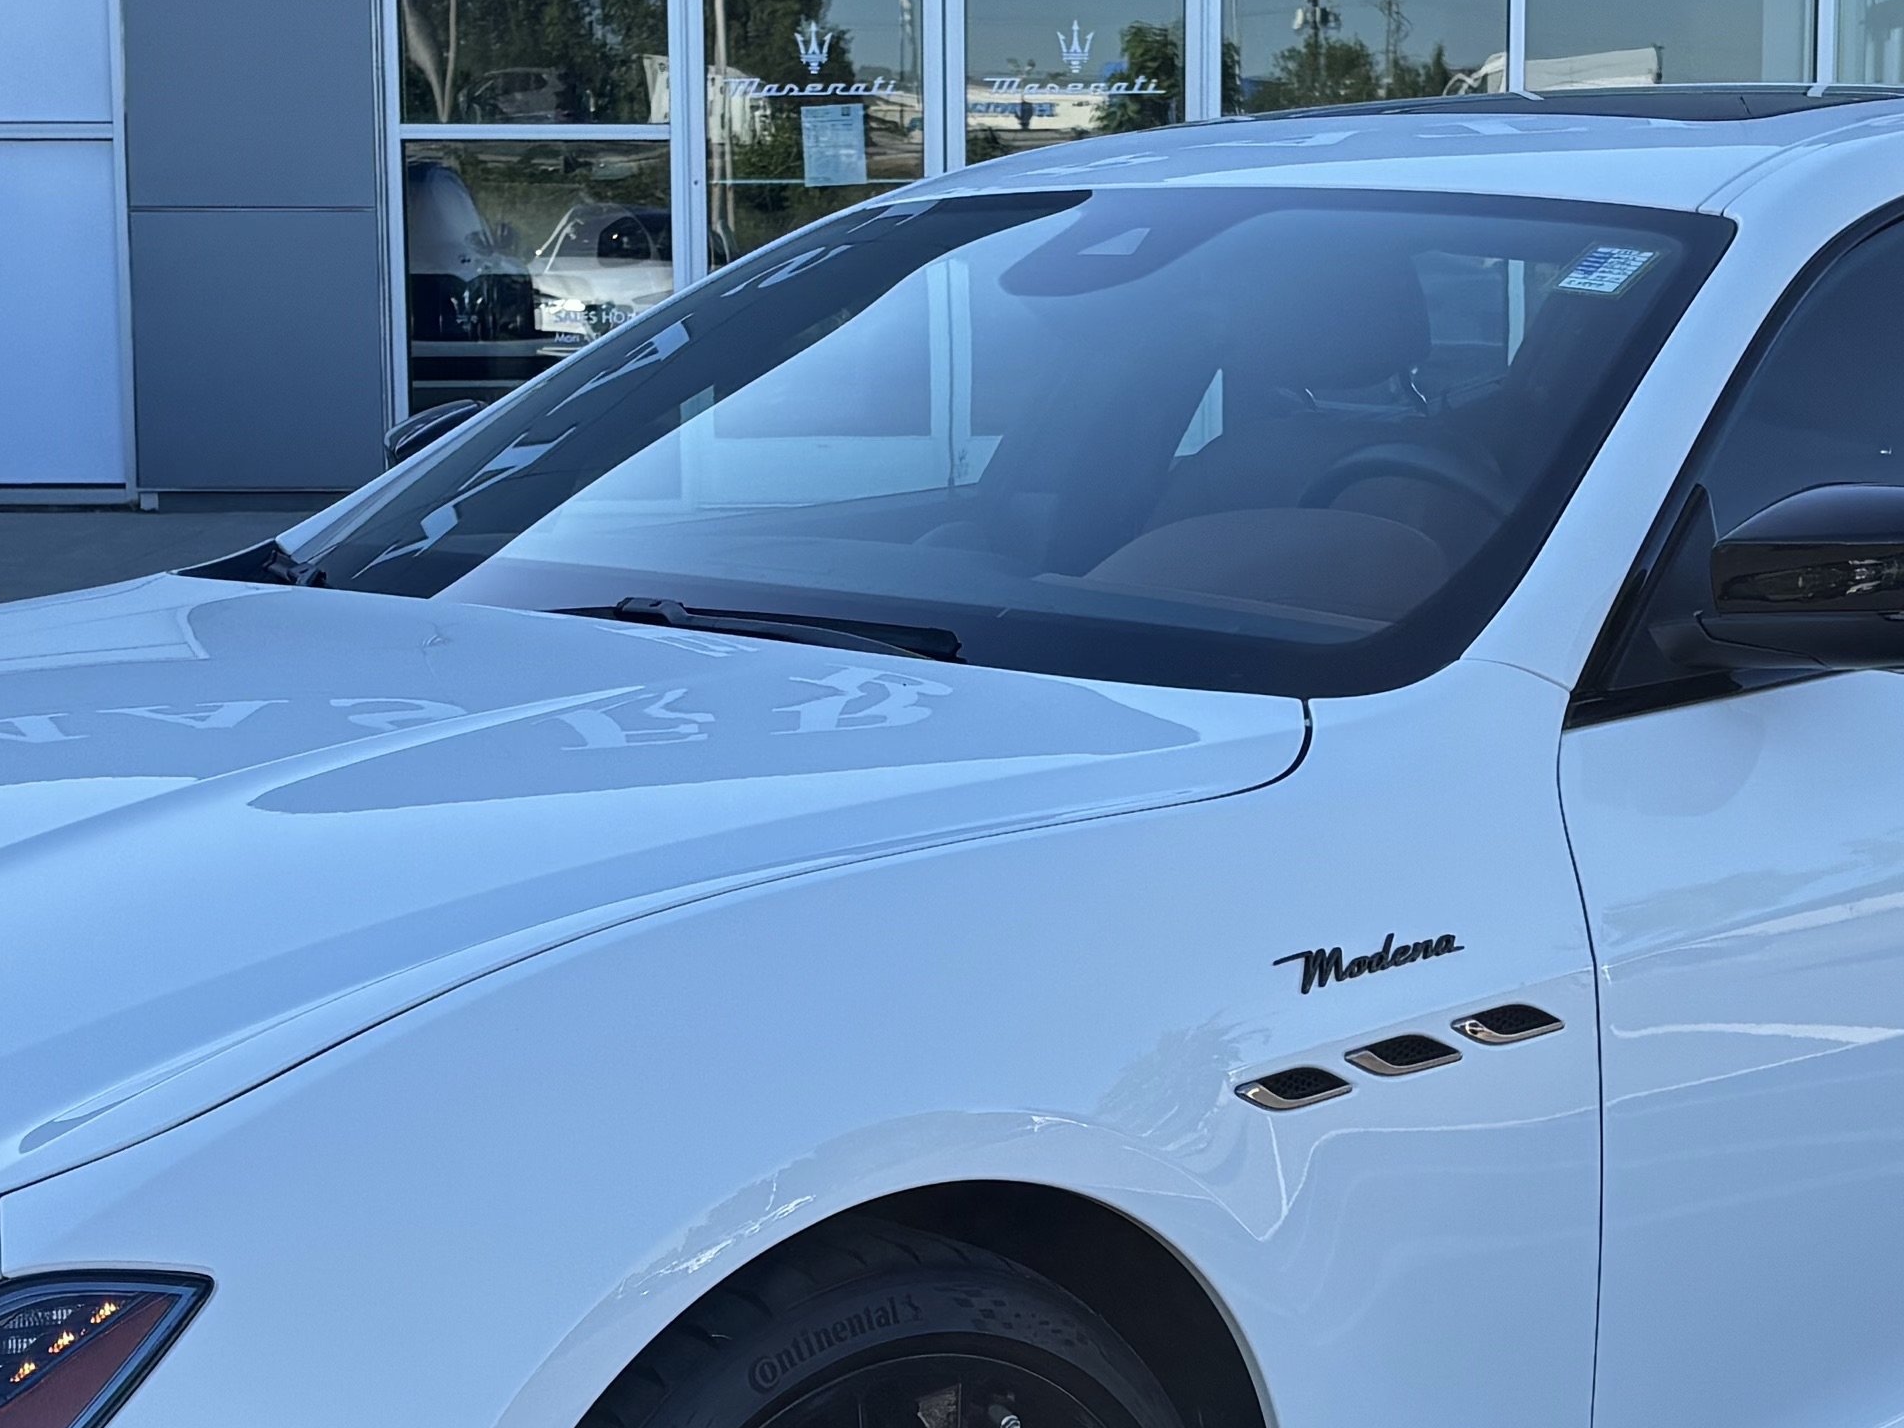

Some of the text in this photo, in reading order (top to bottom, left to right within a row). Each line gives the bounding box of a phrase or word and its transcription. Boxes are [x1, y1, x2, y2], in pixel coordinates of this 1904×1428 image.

[724, 76, 904, 98] Maserati
[983, 75, 1166, 95] Maserati
[554, 311, 598, 324] SALES
[1272, 933, 1465, 995] Modena
[748, 1295, 900, 1394] Continental
